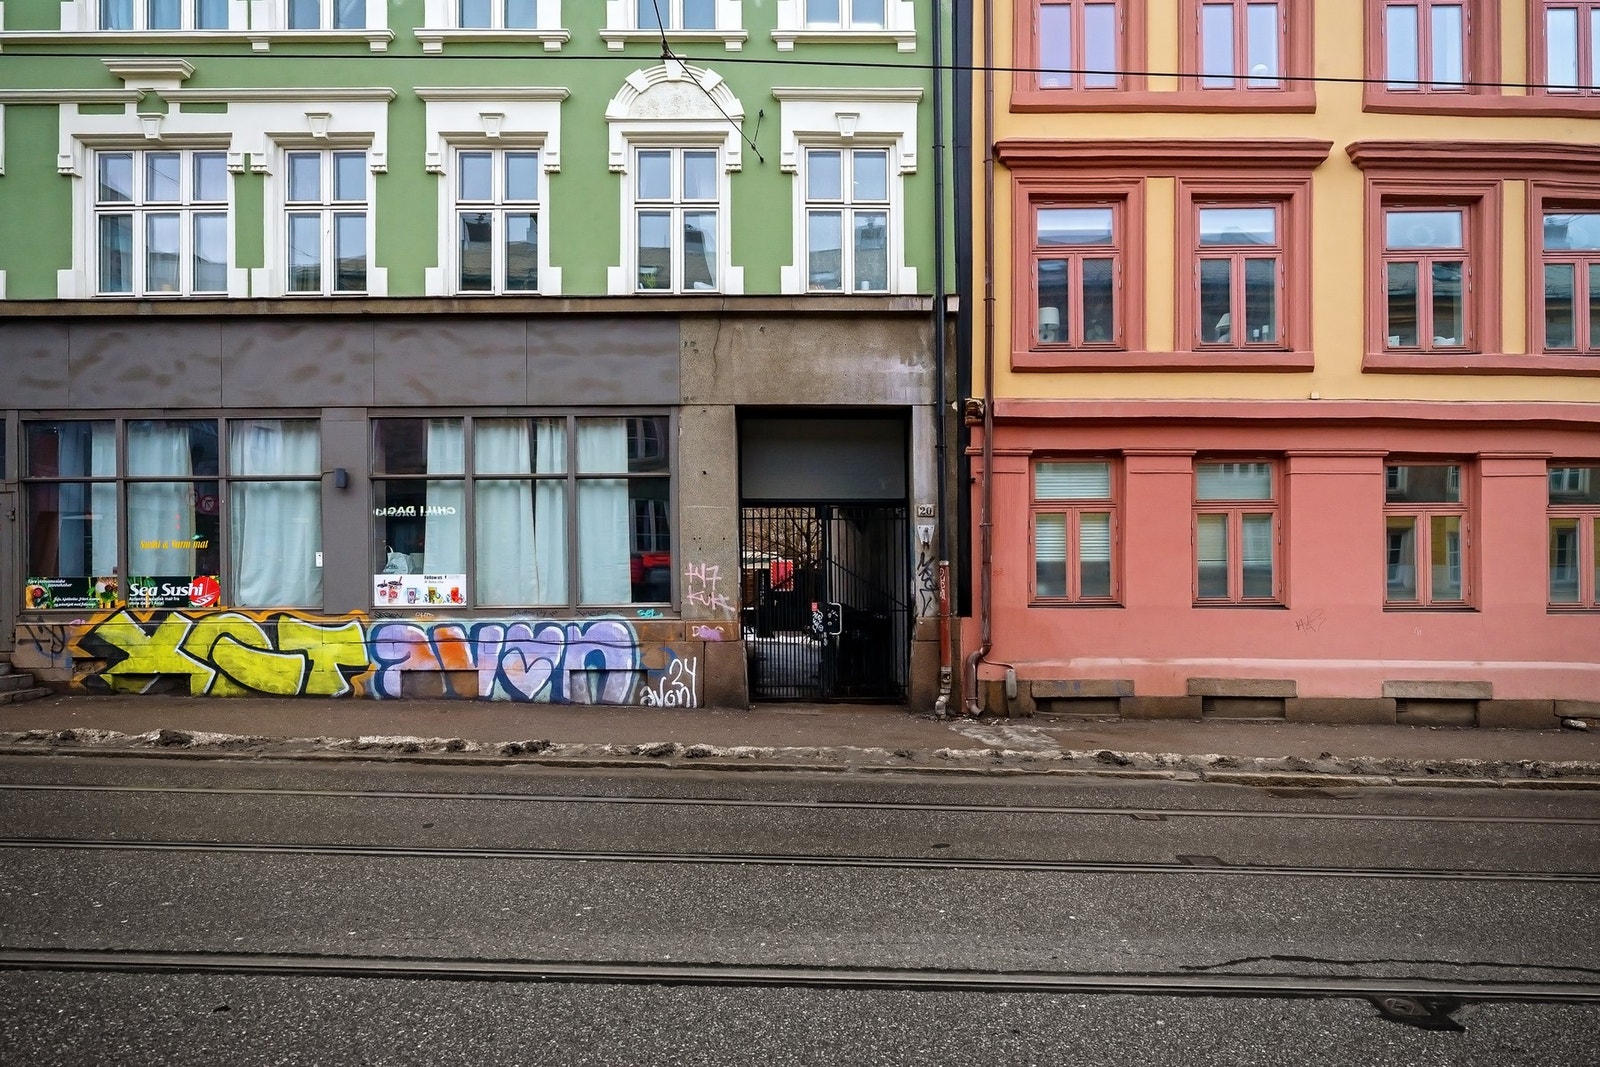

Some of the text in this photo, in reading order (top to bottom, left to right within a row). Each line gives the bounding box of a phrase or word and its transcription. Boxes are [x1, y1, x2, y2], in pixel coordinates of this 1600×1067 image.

[919, 506, 933, 516] 20
[192, 540, 209, 549] mat
[129, 583, 204, 597] Sea Sushi
